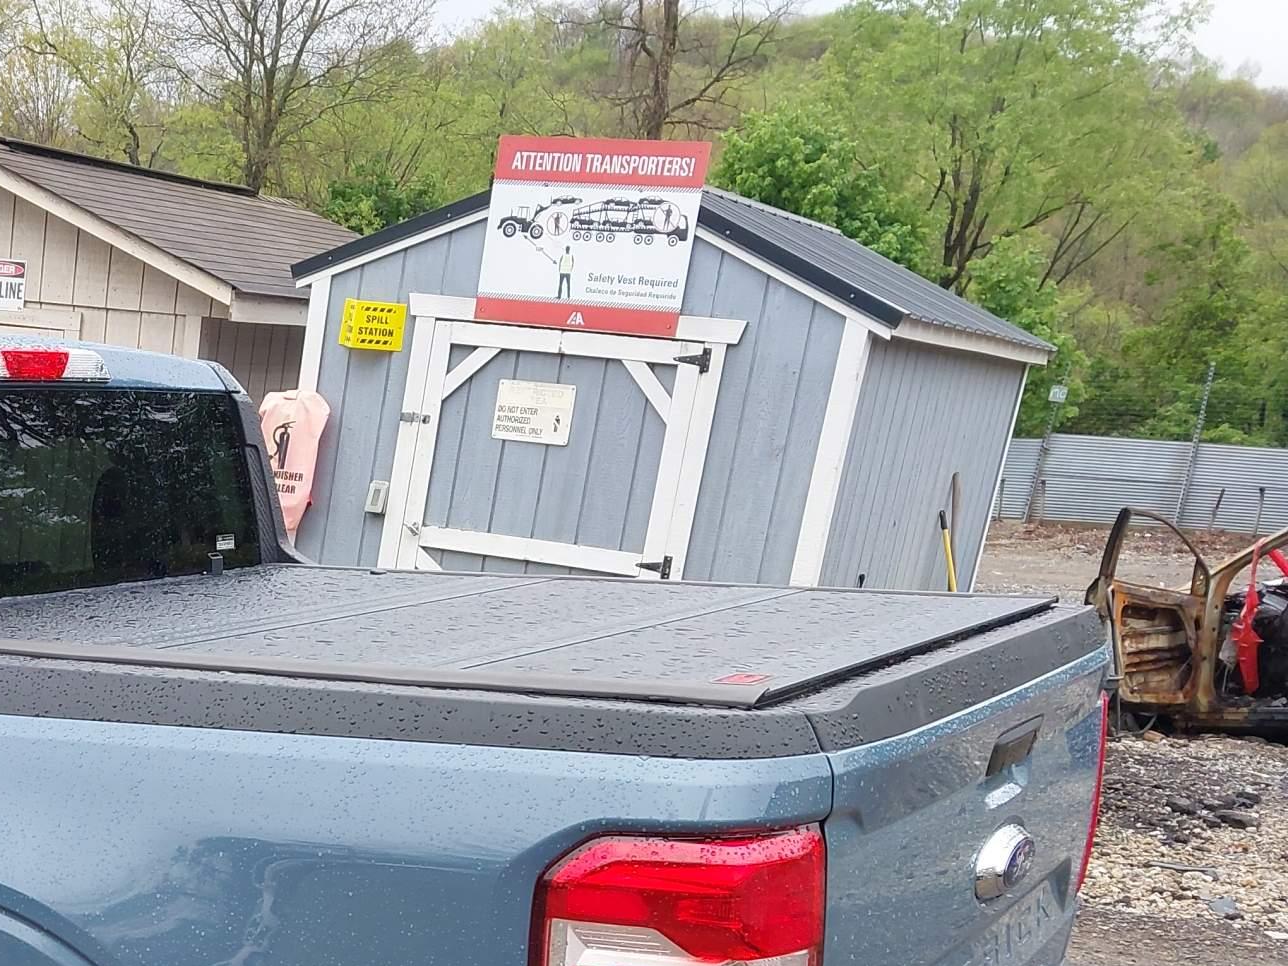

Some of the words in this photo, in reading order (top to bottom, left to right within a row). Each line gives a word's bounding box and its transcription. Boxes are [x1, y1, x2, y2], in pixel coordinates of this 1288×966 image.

[511, 151, 583, 171] ATTENTION
[585, 154, 696, 177] TRANSPORTERS!
[587, 272, 615, 285] Safety
[617, 274, 637, 286] Vest
[638, 276, 679, 288] Required
[366, 315, 389, 325] SPILL
[358, 327, 394, 337] STATION
[497, 404, 506, 413] DO
[507, 405, 519, 414] NOT
[520, 407, 538, 416] ENTER
[495, 424, 527, 434] PERSONNEL
[528, 427, 543, 436] ONLY
